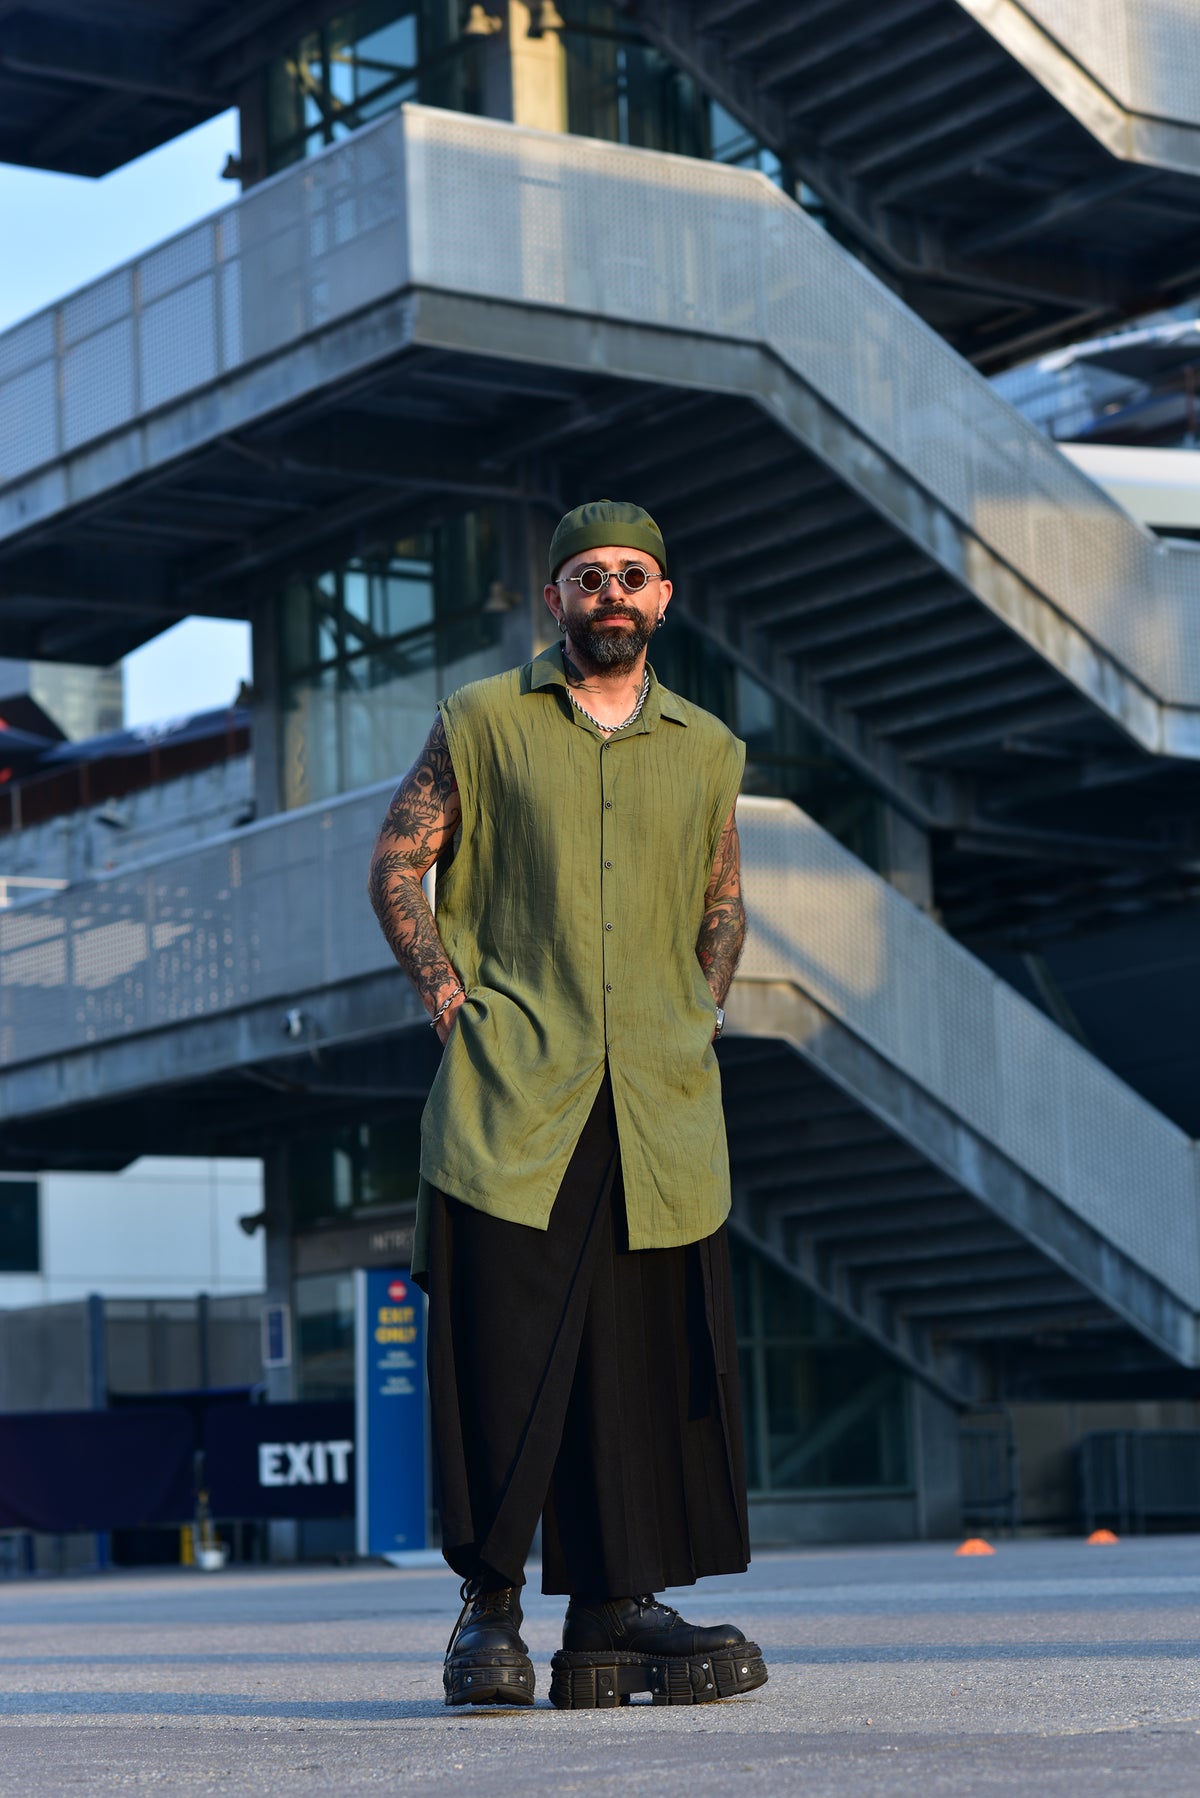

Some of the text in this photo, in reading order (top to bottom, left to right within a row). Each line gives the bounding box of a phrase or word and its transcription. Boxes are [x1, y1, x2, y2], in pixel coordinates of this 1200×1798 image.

[379, 1307, 414, 1324] EXIT
[375, 1328, 417, 1343] ONLY
[260, 1441, 352, 1486] EXIT
